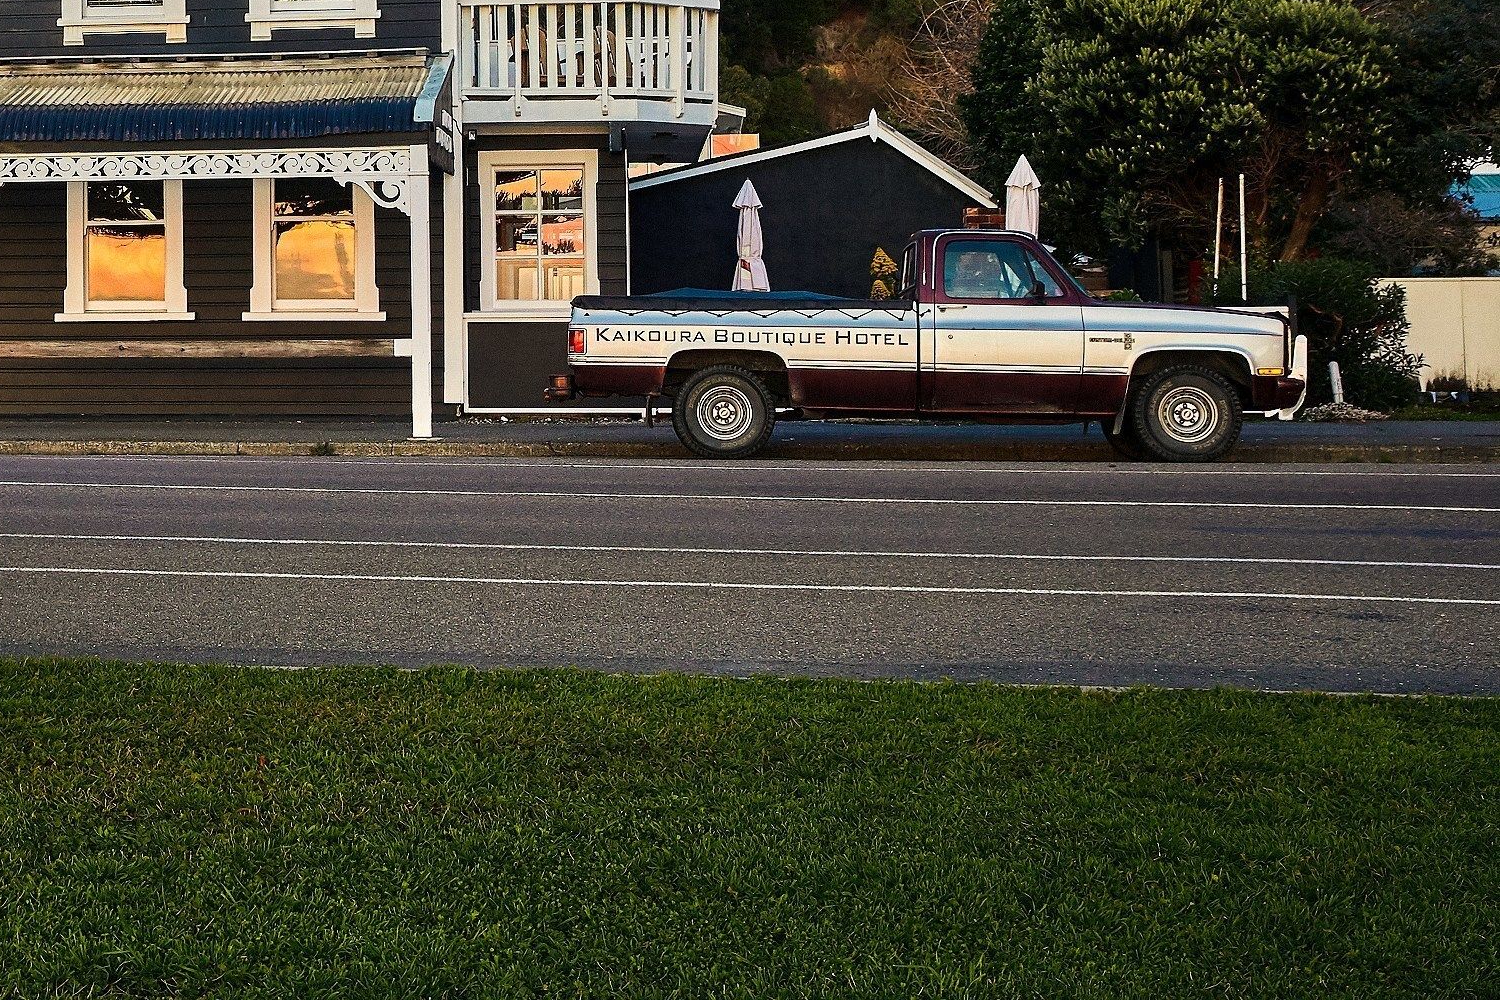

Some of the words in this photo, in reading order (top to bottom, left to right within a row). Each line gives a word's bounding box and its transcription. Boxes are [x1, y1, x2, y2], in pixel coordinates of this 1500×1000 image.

[596, 328, 706, 342] KAIKOURA
[714, 330, 826, 346] BOUTIQUE
[835, 331, 909, 345] HOTEL
